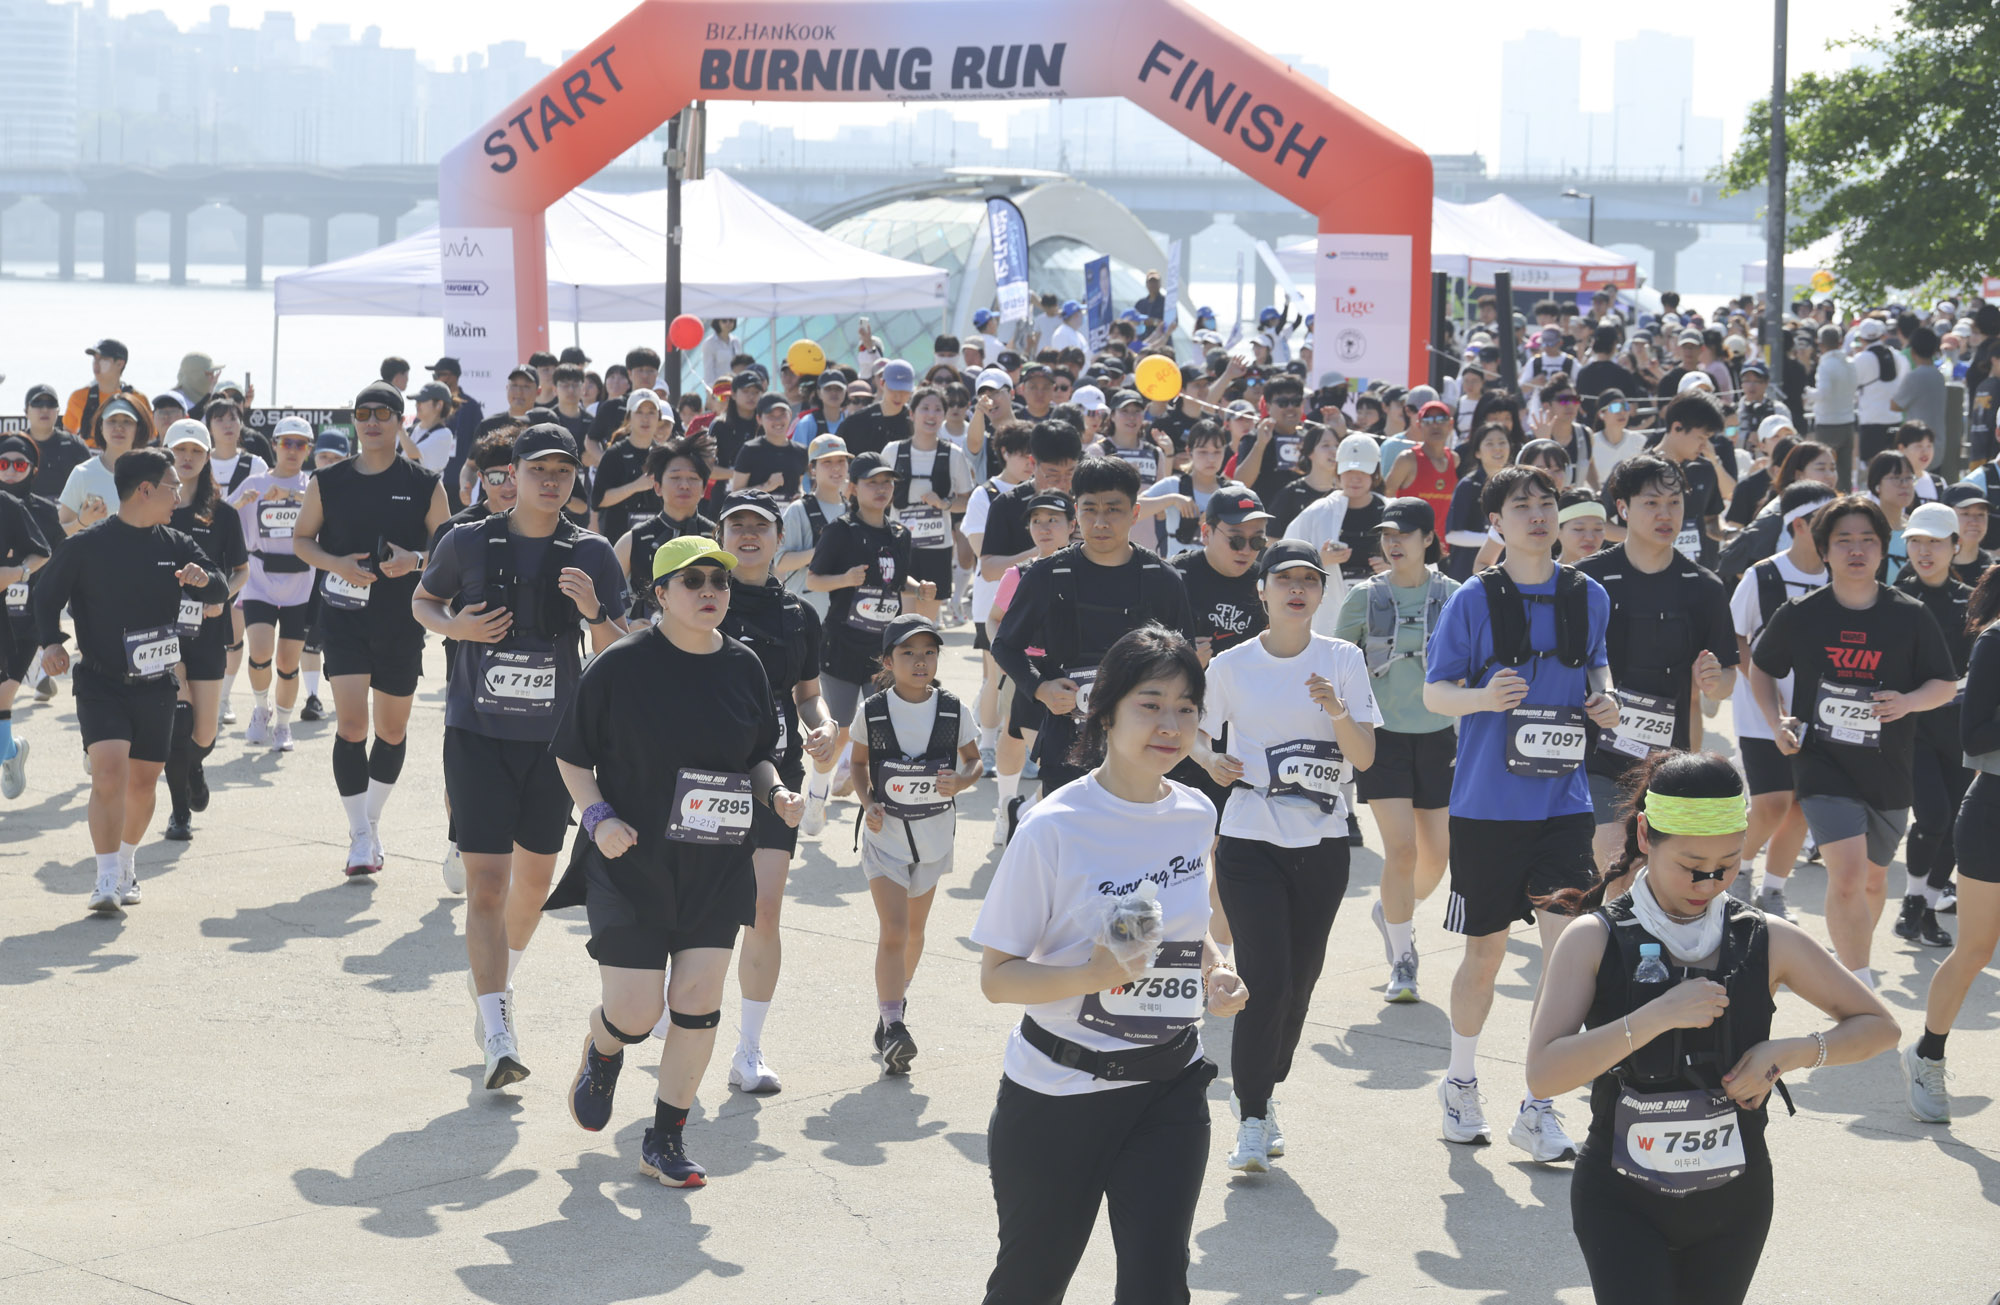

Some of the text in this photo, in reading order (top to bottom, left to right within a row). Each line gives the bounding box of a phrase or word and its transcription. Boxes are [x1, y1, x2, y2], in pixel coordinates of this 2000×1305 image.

[700, 43, 1067, 91] BURNING RUN
[484, 44, 624, 174] START
[1138, 39, 1328, 179] FINISH
[1333, 297, 1375, 318] Tage
[447, 321, 487, 338] Maxim
[276, 511, 297, 520] 800
[1678, 534, 1697, 545] 228
[179, 605, 200, 616] 701
[1215, 603, 1244, 621] Fly
[1208, 613, 1252, 635] Nike!
[138, 643, 178, 661] M 7158
[1824, 646, 1882, 671] RUN
[492, 673, 554, 688] M 7192
[1825, 705, 1835, 714] M
[1619, 715, 1673, 735] M 7255
[1524, 731, 1584, 748] M 7097
[1287, 763, 1340, 782] M 7098
[892, 782, 937, 794] W 791
[689, 797, 750, 816] W 7895
[688, 815, 717, 829] D-213
[1180, 949, 1196, 957] 7km
[1133, 977, 1198, 999] 7586
[1621, 1095, 1690, 1110] BURNING RUN
[1637, 1123, 1735, 1153] W 7587
[1674, 1158, 1700, 1168] 이두리
